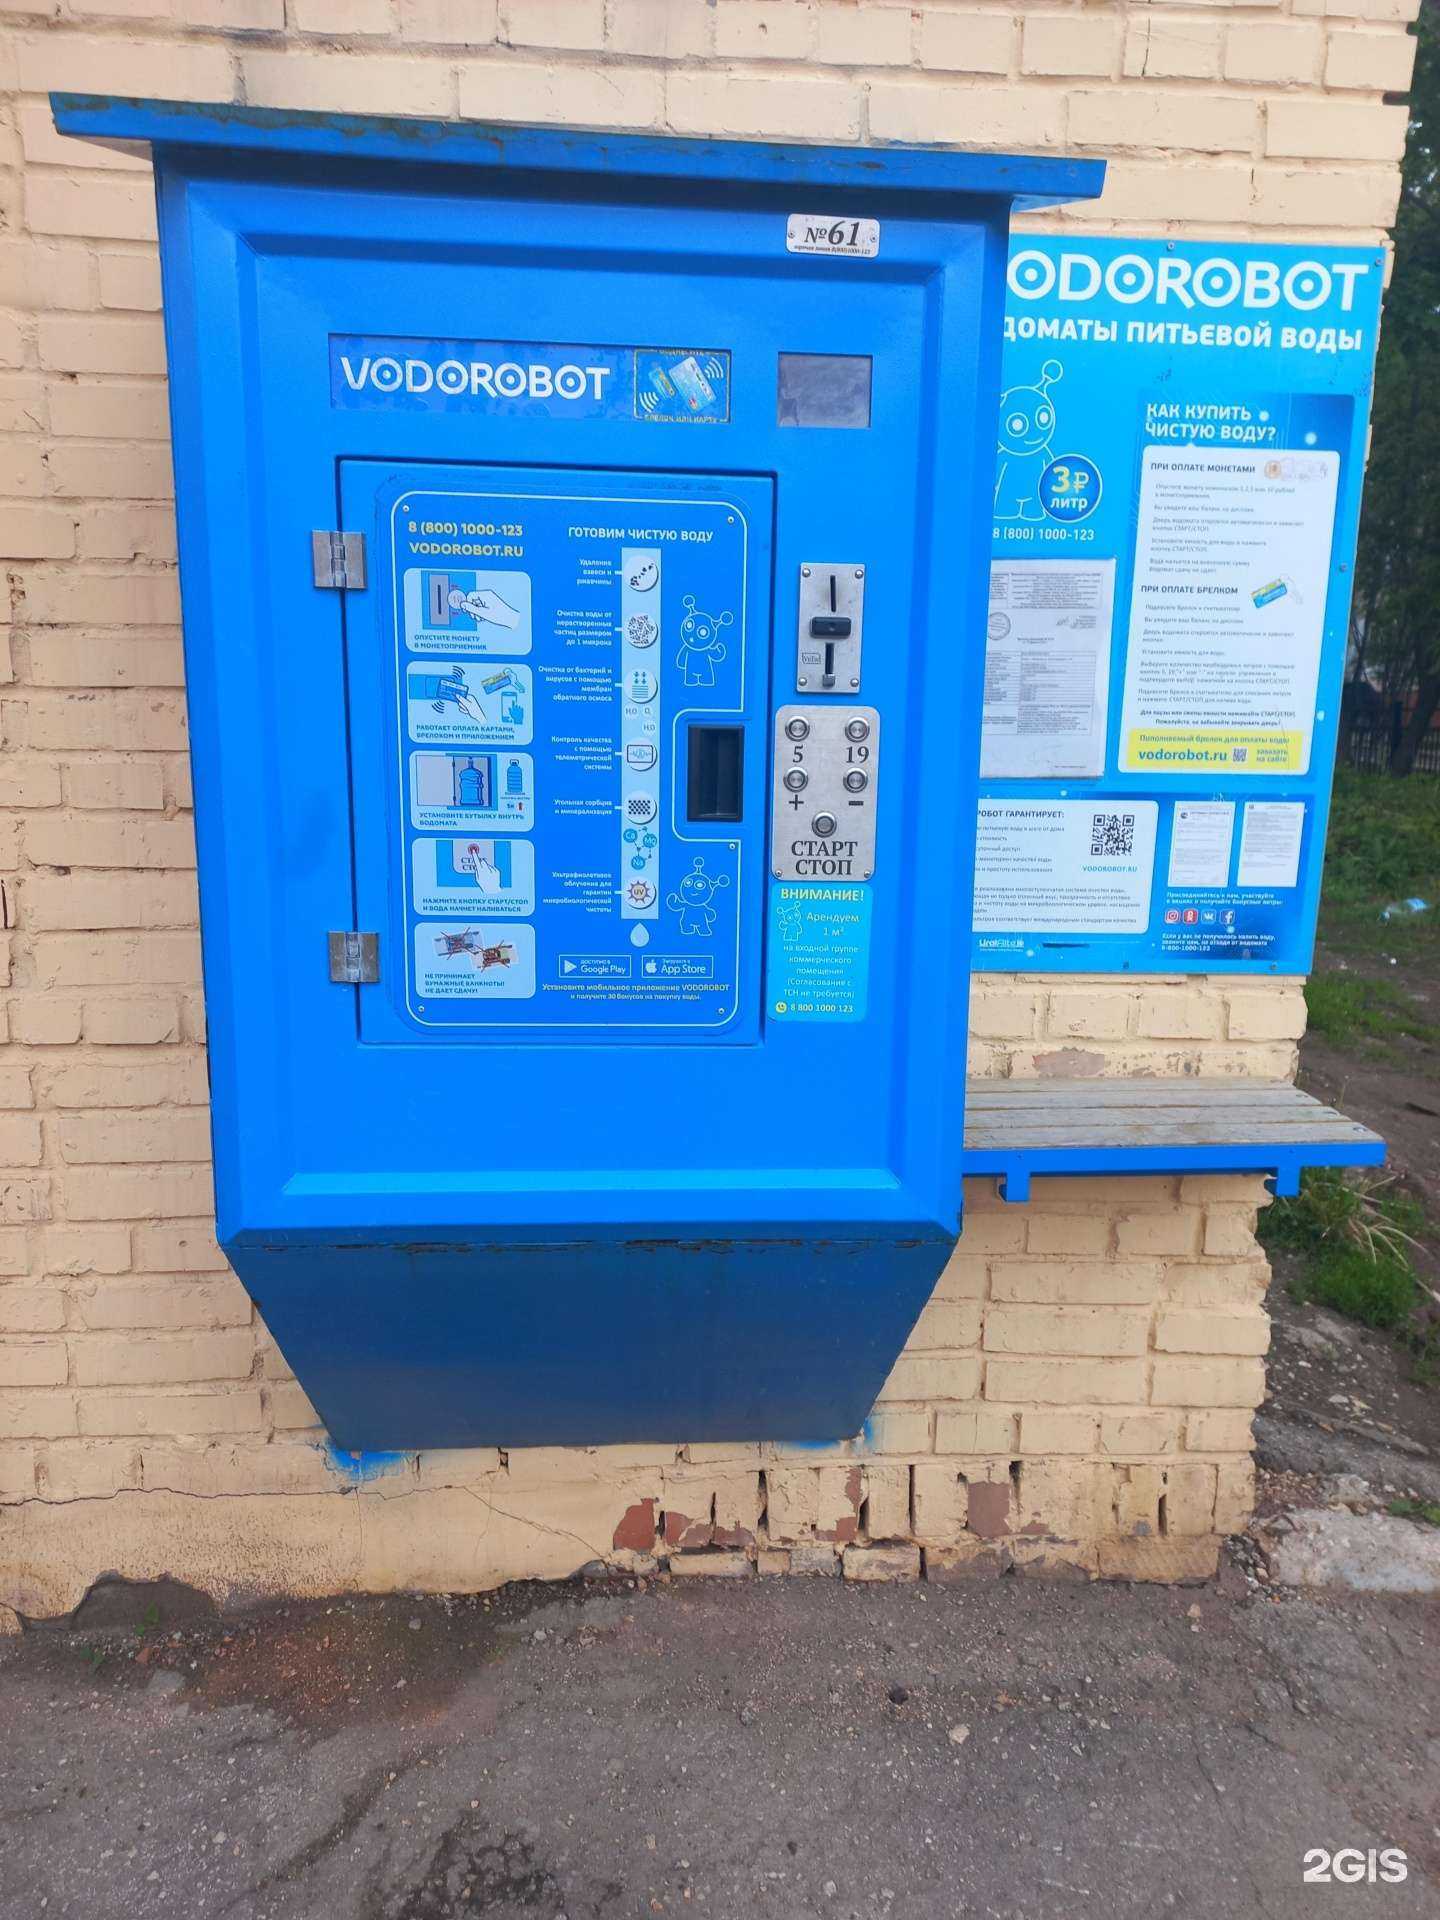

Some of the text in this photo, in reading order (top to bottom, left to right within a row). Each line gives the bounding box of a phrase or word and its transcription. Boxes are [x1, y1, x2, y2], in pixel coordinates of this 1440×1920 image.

[1127, 320, 1271, 347] ПИТЬЕВОЙ
[1280, 329, 1362, 353] ВОДЫ
[341, 356, 610, 400] VODOROBOT
[1147, 403, 1251, 421] КАК КУПИТЬ
[1145, 422, 1276, 442] ЧИСТУЮ ВОДУ?
[1151, 462, 1255, 473] ПРИ ОПЛАТЕ МОНЕТАМИ
[1050, 497, 1087, 512] литр
[408, 522, 522, 536] 8 (800) 1000-123
[568, 526, 713, 543] ГОТОВИМ ЧИСТУЮ ВОДУ
[1004, 528, 1033, 540] (800)
[1039, 529, 1094, 541] 1000-123
[410, 542, 523, 556] VODOROBOT.RU
[1141, 585, 1238, 594] ПРИ ОПЛАТЕ БРЕЛКОМ
[557, 610, 584, 618] Очистка
[586, 611, 603, 619] воды
[421, 642, 486, 650] МОНЕТОПРИЕМНИК
[538, 666, 566, 674] Очистка
[575, 666, 606, 675] бактерий
[792, 745, 869, 763] 5 19
[1139, 748, 1227, 761] vodorobot.ru
[791, 841, 858, 857] СТАРТ
[795, 860, 852, 875] СТОП
[781, 888, 864, 901] ВНИМАНИЕ!
[806, 912, 860, 923] Арендуем
[581, 965, 626, 975] Google Play
[661, 965, 680, 975] App
[542, 984, 585, 992] Установите
